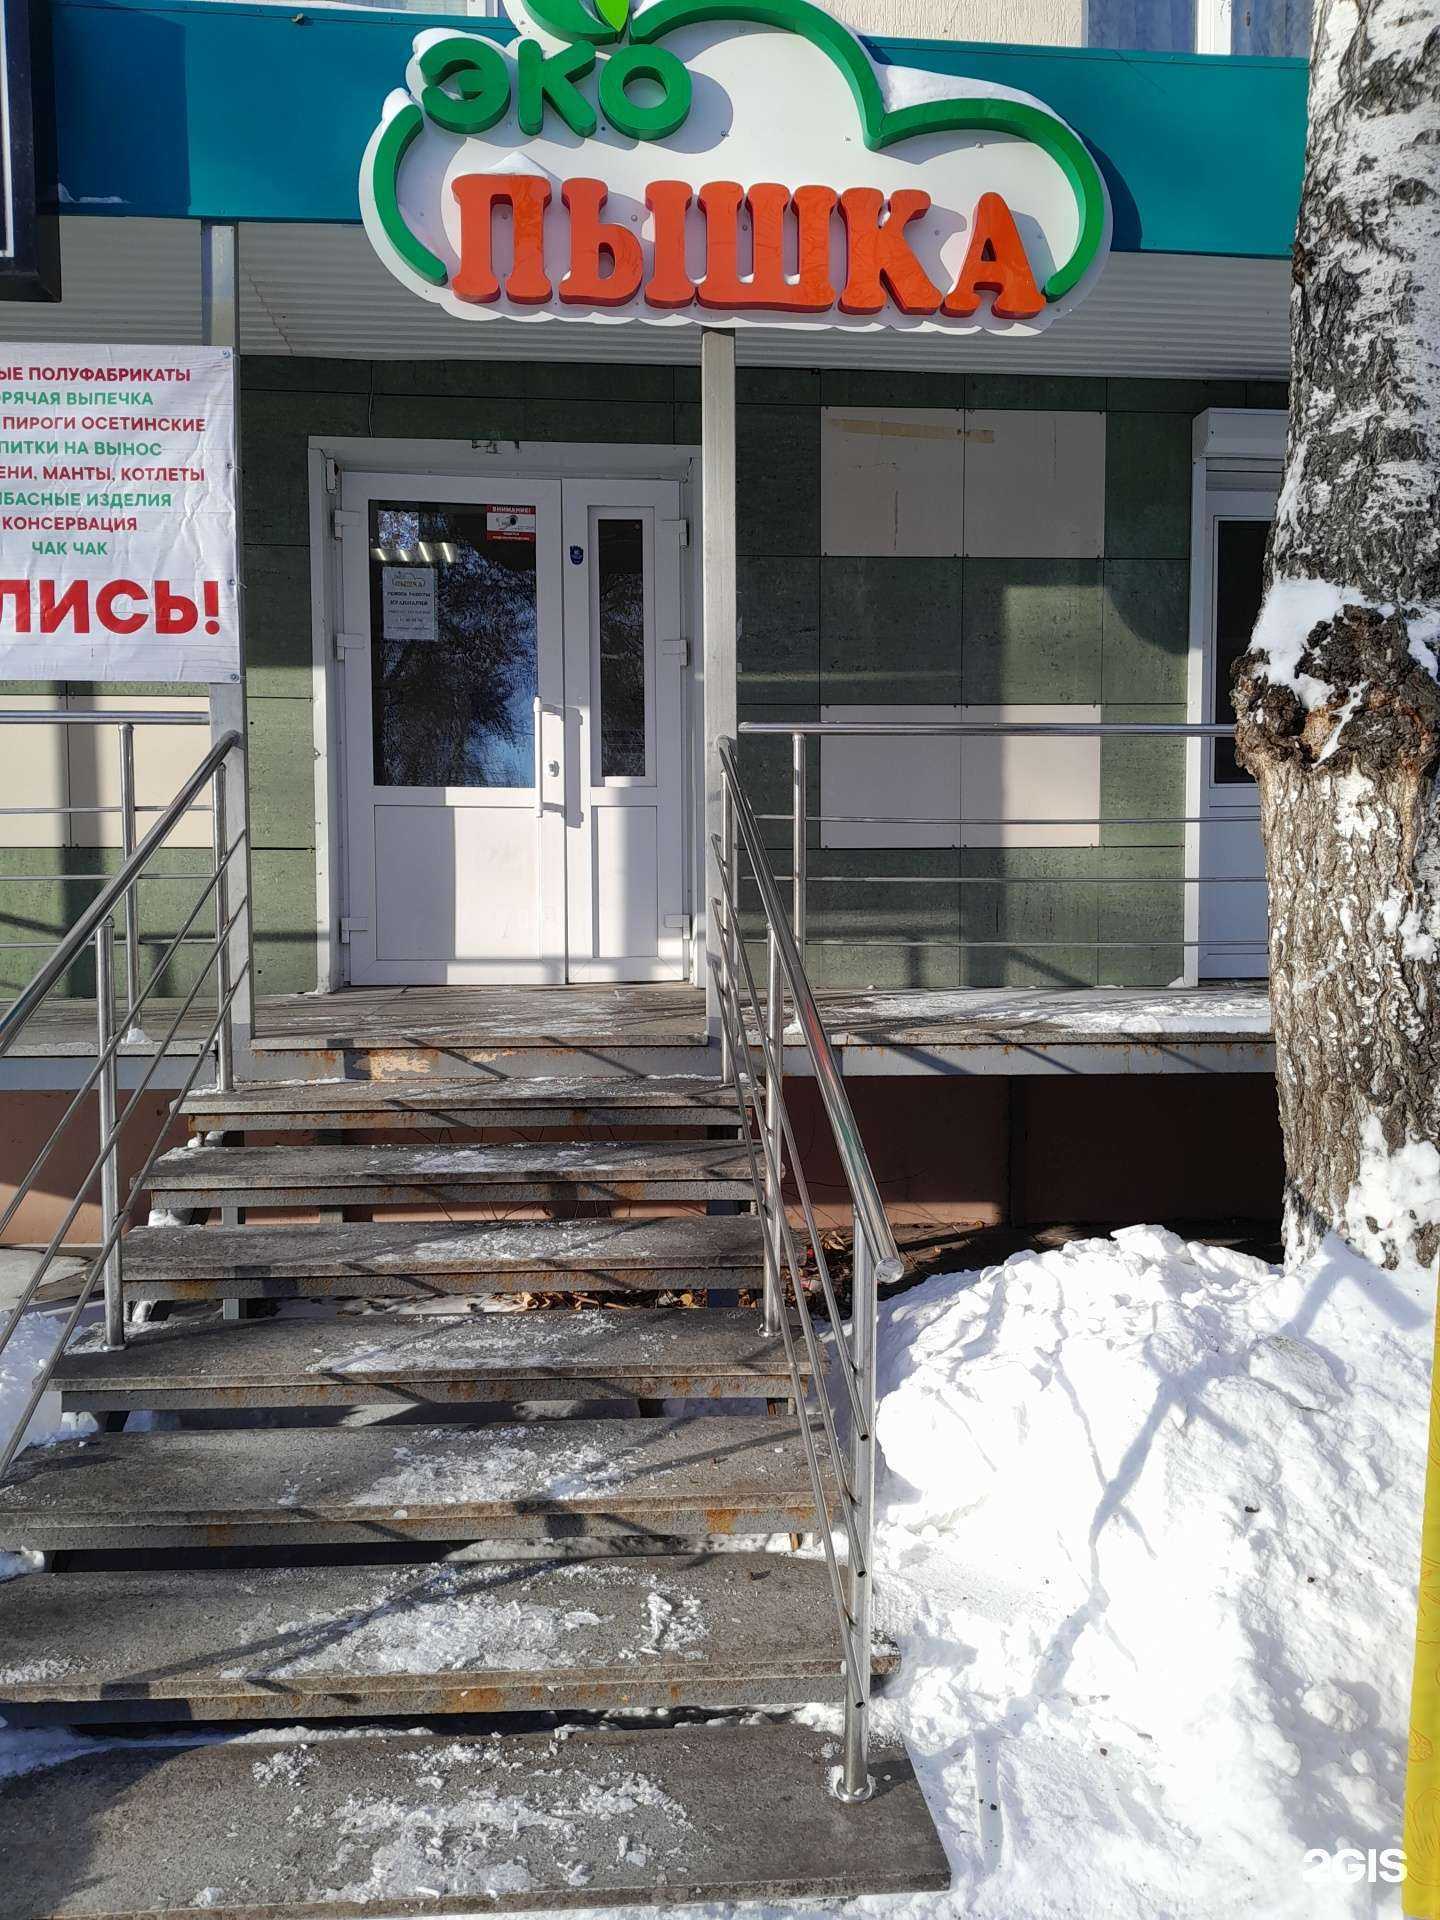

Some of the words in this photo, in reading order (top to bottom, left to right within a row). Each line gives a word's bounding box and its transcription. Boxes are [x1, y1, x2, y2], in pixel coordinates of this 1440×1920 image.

[421, 36, 692, 141] ЭКО
[451, 174, 1047, 319] ПЫШКА
[29, 367, 190, 382] ПОЛУФАБРИКАТЫ
[0, 391, 60, 405] РЯЧАЯ
[66, 392, 153, 405] ВЫПЕЧКА
[3, 416, 76, 430] ПИРОГИ
[82, 416, 206, 432] ОСЕТИНСКИЕ
[0, 441, 58, 454] ПИТКИ
[64, 441, 89, 455] НА
[94, 442, 162, 456] ВЫНОС
[43, 466, 116, 482] МАНТЫ,
[121, 467, 205, 481] КОТЛЕТЫ
[0, 492, 81, 506] БАСНЫЕ
[87, 493, 171, 509] ИЗДЕЛИЯ
[3, 516, 137, 533] КОНСЕРВАЦИЯ
[32, 541, 67, 555] ЧАК
[73, 541, 108, 555] ЧАК
[0, 579, 220, 635] ЛИСЬ!
